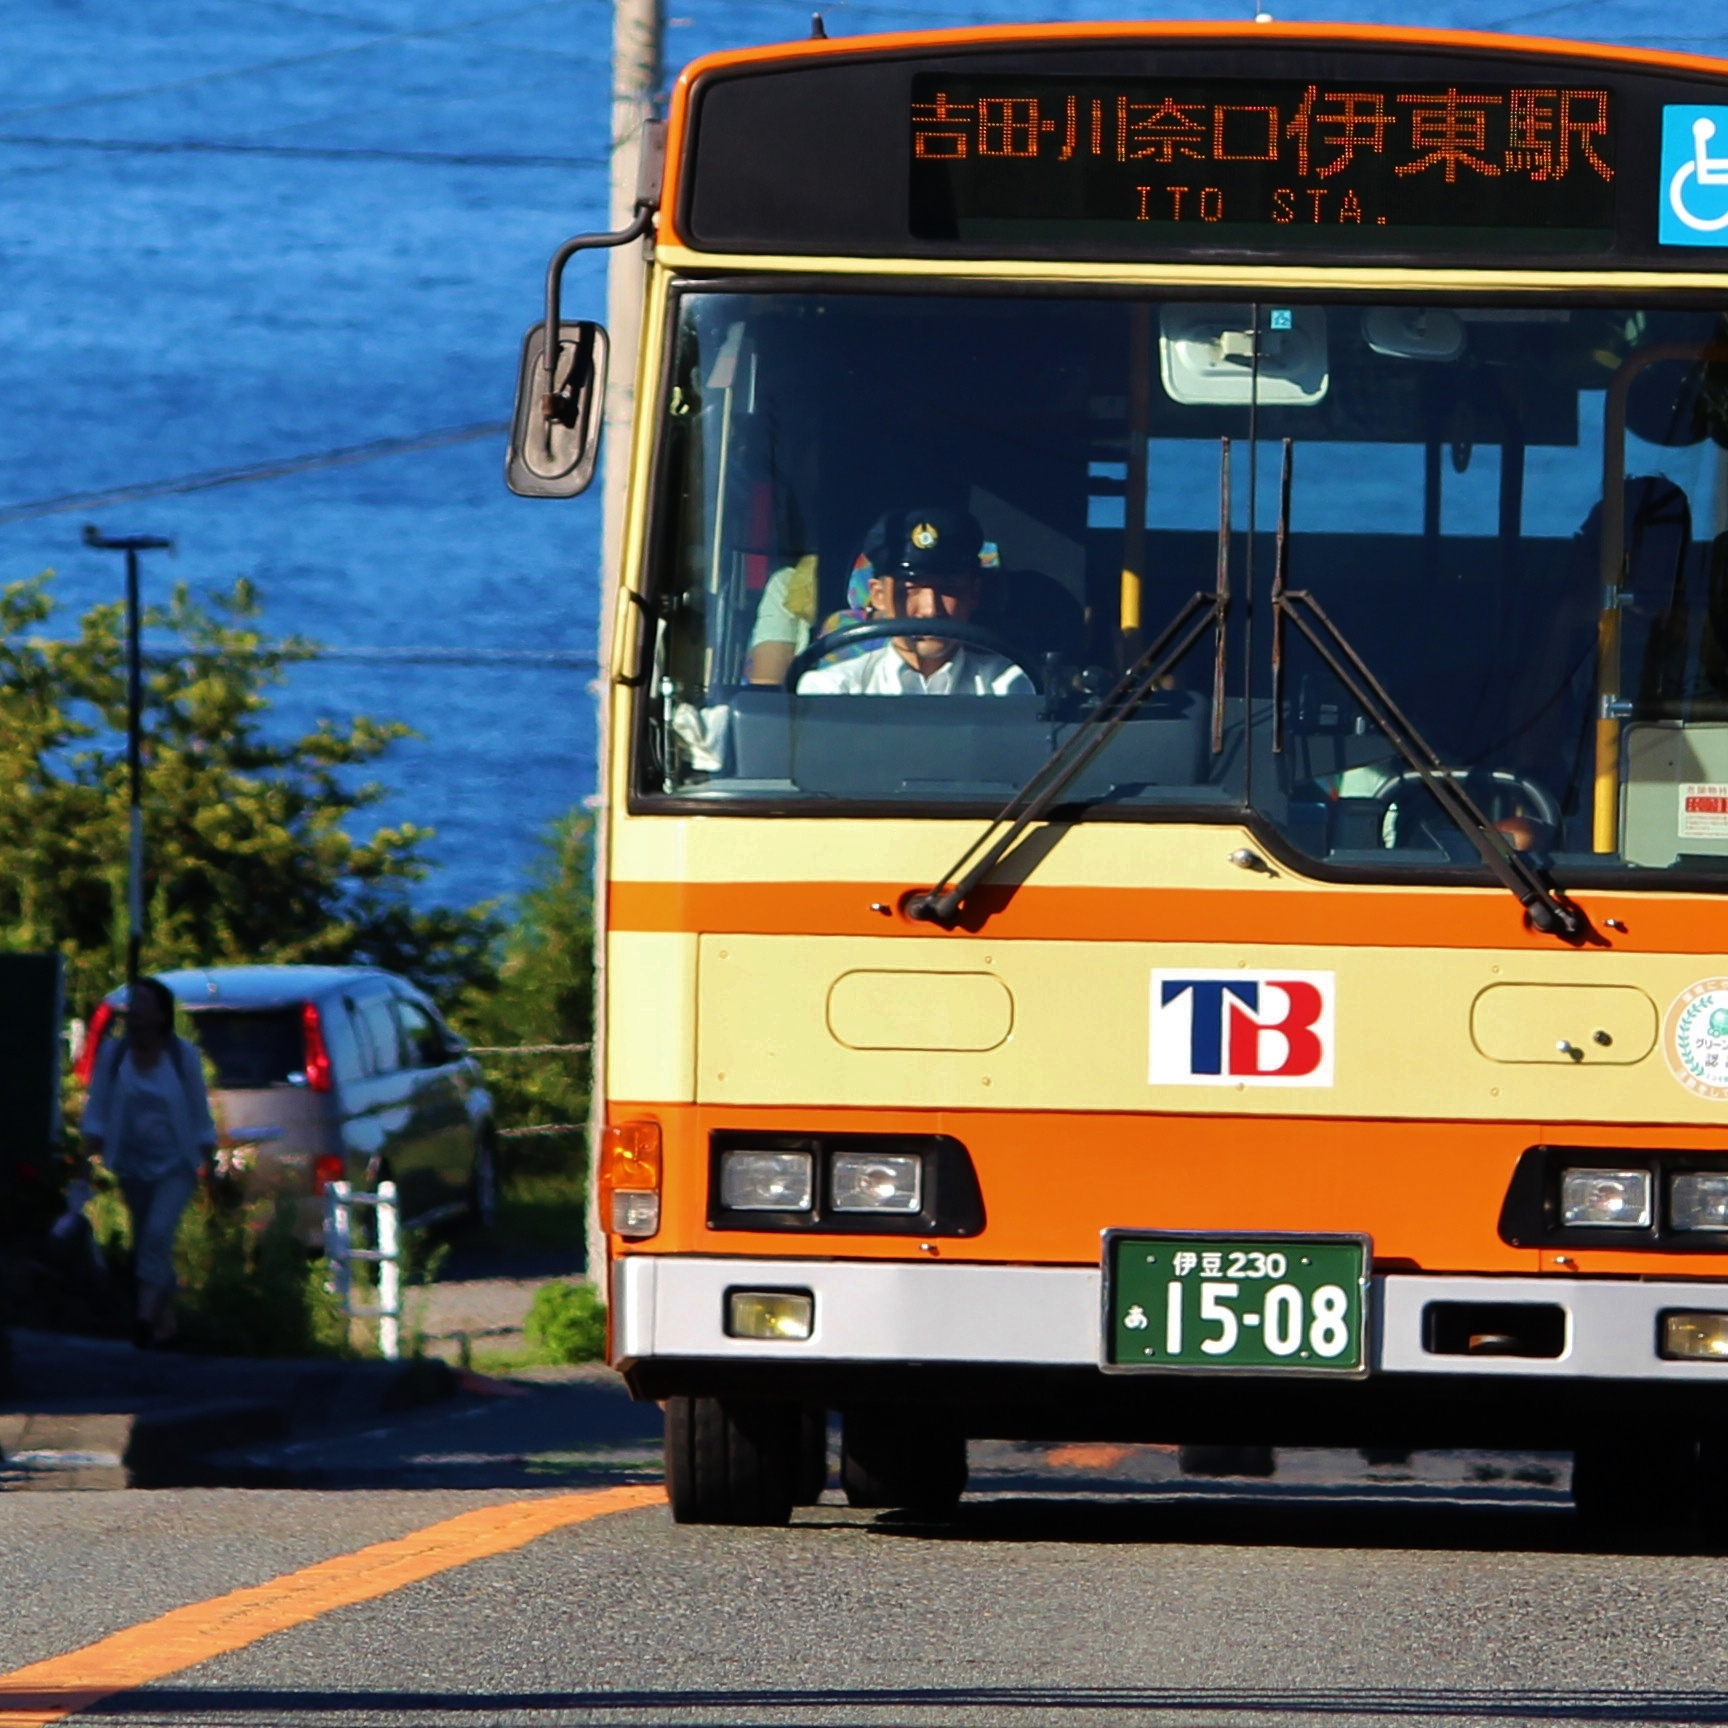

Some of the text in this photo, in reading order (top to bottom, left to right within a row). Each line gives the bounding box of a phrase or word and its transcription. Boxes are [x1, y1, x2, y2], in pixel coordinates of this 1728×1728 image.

[1136, 186, 1386, 224] ITO STA.
[1161, 979, 1323, 1077] TB
[1124, 1281, 1349, 1358] あ 15-08
